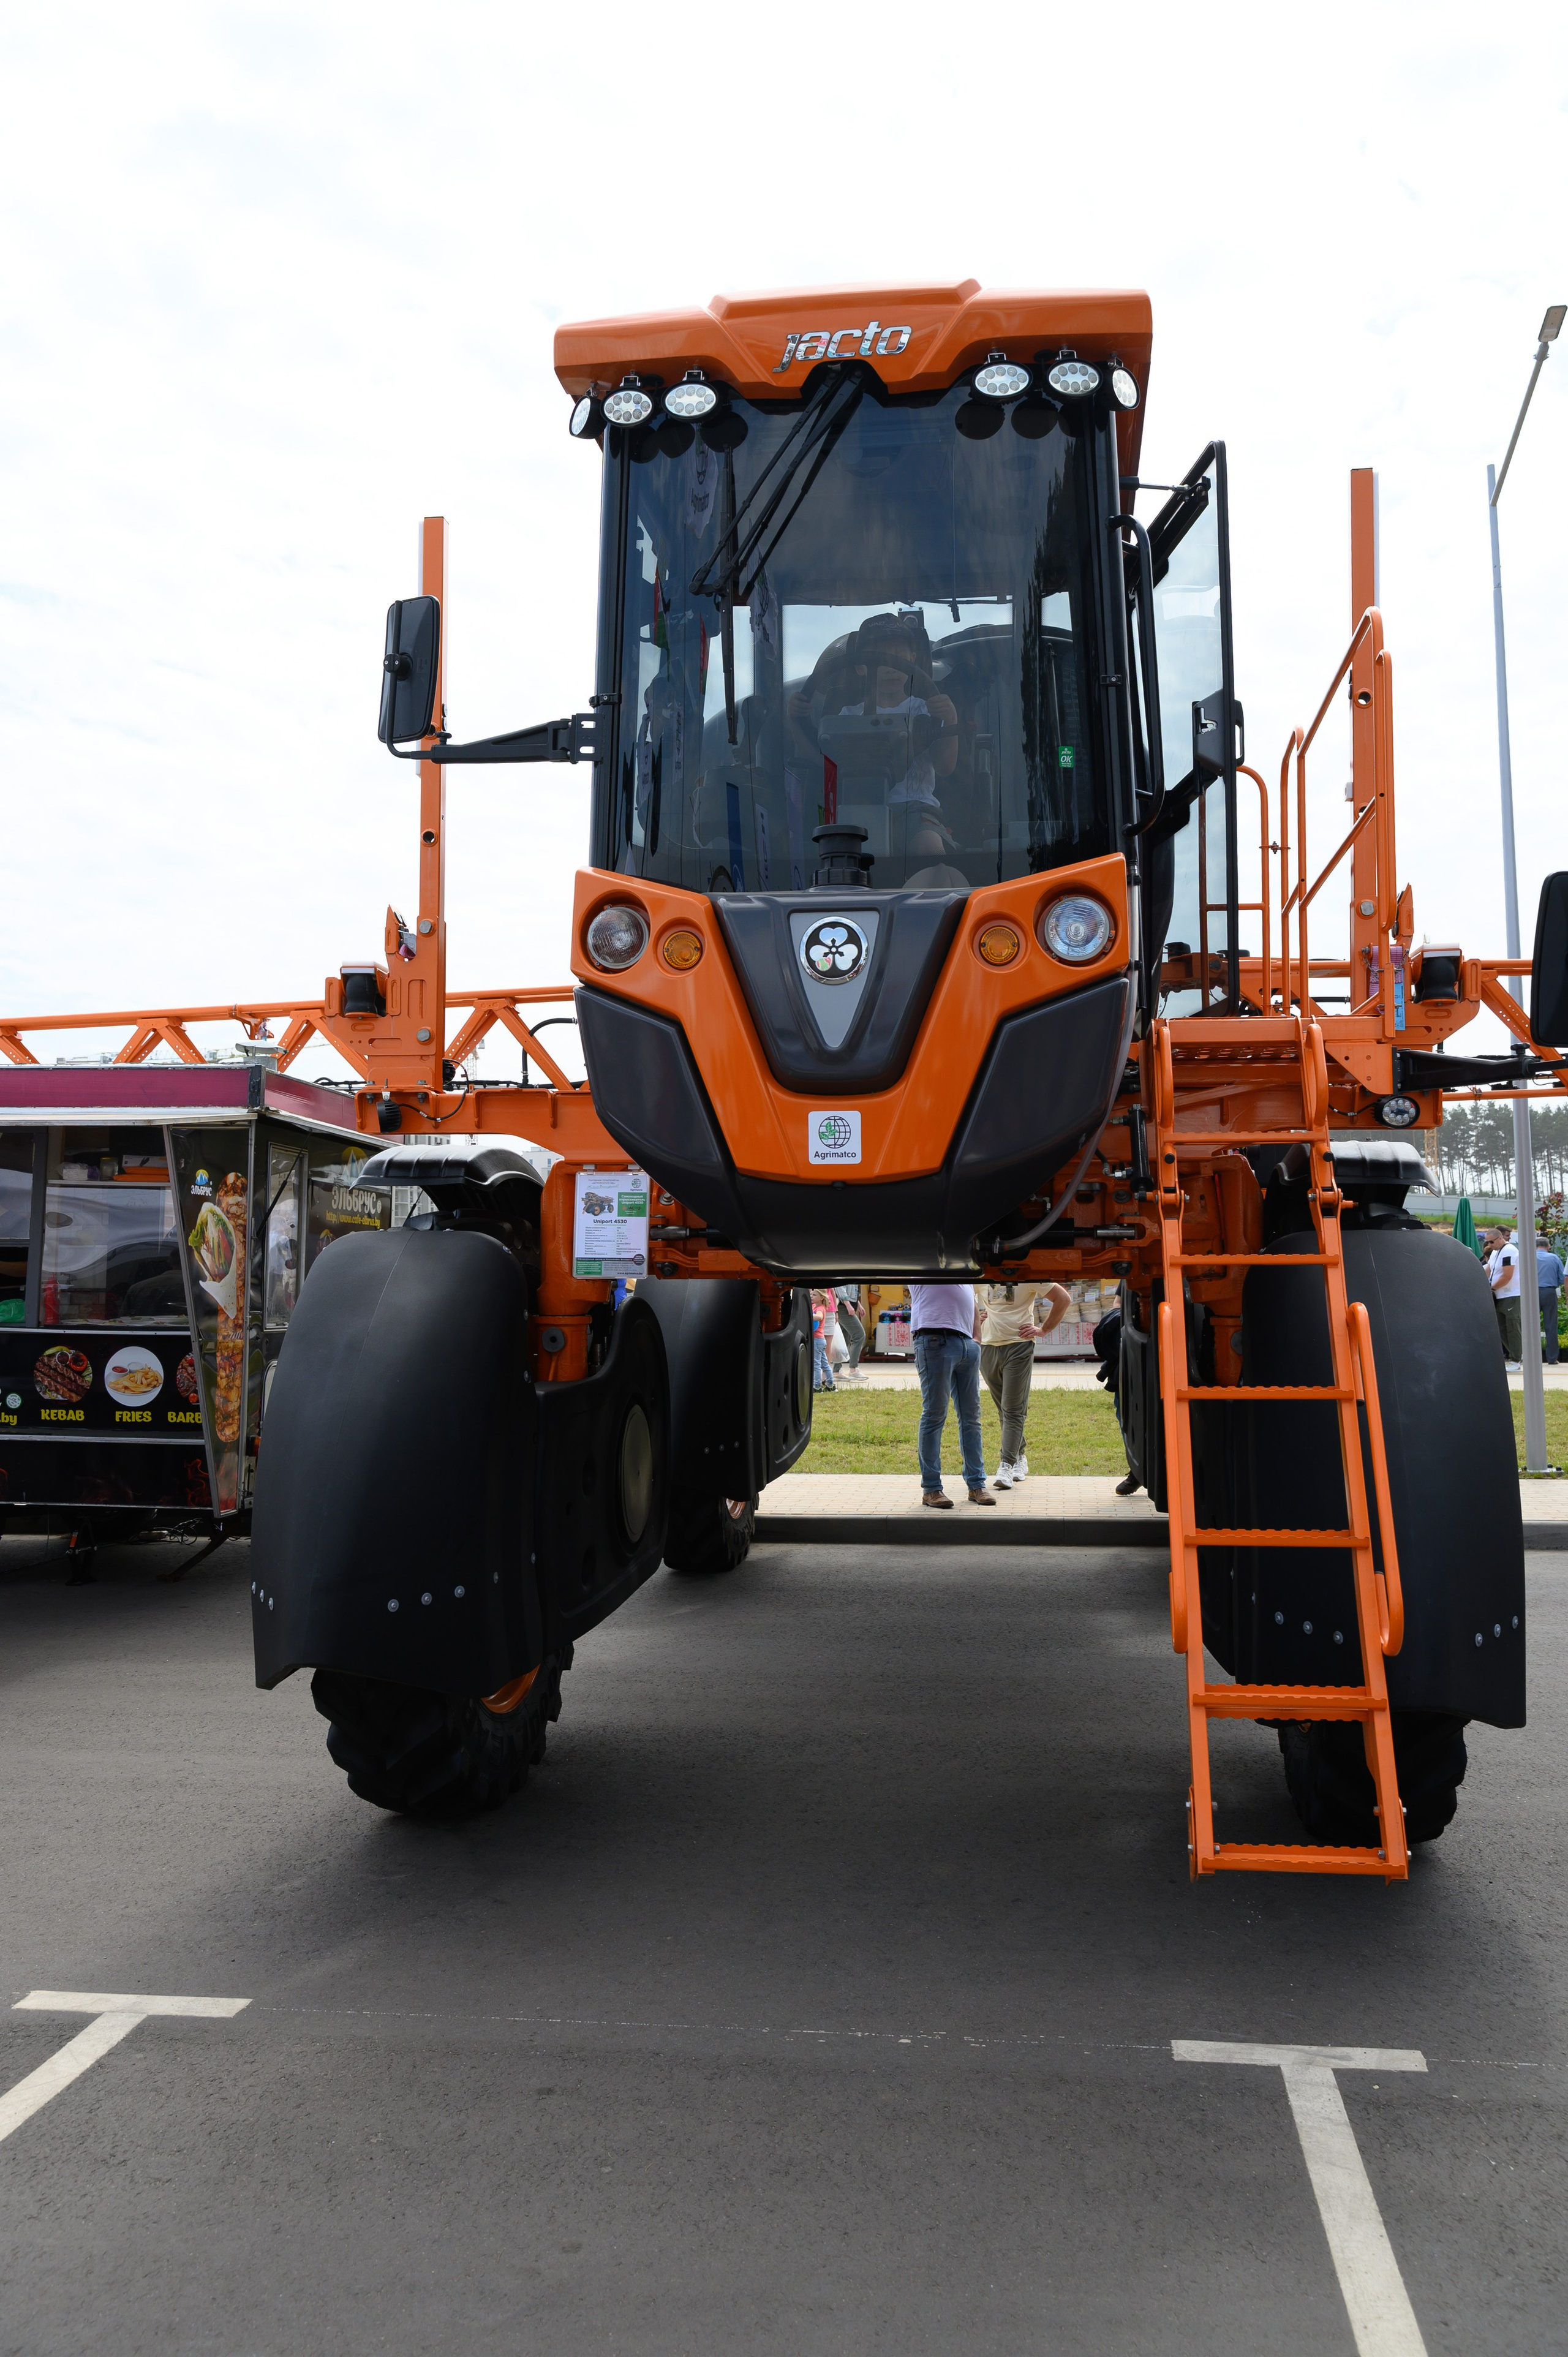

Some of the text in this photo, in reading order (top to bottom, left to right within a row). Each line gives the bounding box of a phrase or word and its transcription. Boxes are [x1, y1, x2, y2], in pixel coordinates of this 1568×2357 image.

[772, 320, 912, 373] jacto
[814, 1151, 856, 1160] Agrimatco
[190, 1185, 212, 1196] ЭЛЬБРУС
[331, 1186, 376, 1215] ЭЛЬБРУС
[41, 1409, 85, 1420] KEBAB
[115, 1411, 152, 1422] FRIES
